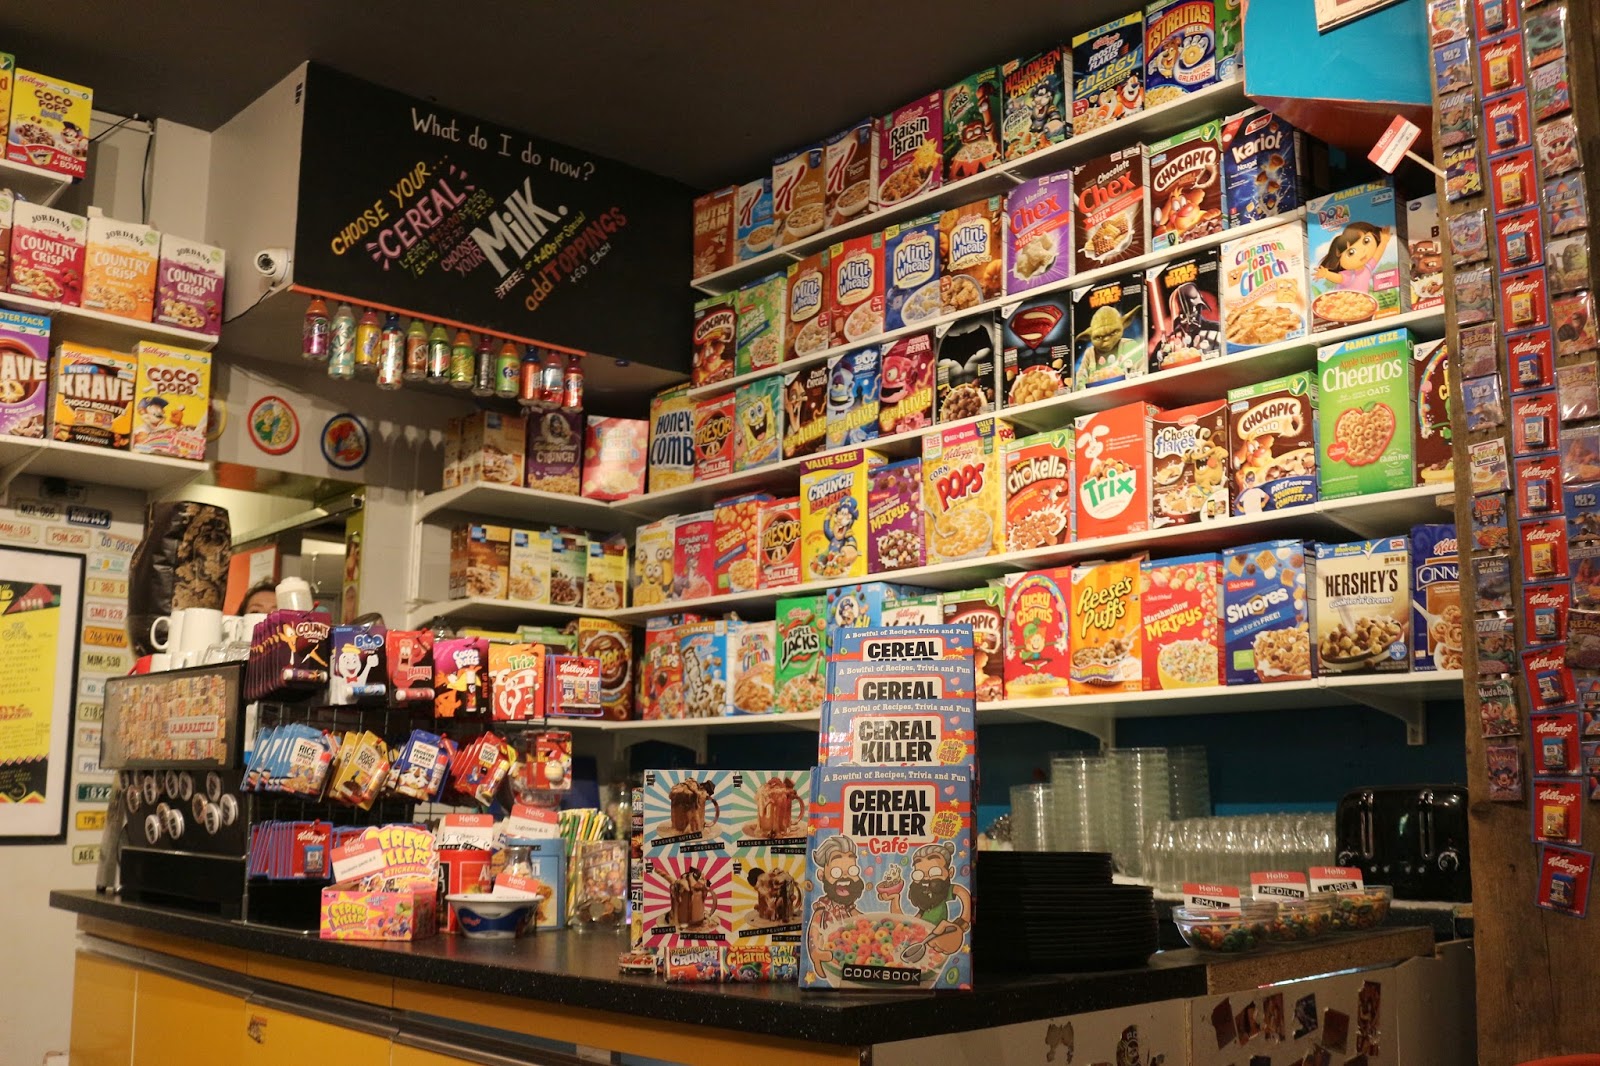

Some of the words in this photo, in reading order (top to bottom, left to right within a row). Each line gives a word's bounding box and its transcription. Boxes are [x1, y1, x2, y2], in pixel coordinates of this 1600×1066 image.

[1088, 17, 1126, 38] NEW!
[1147, 5, 1210, 51] ESTRELITAS
[1185, 25, 1206, 35] MEL
[1088, 38, 1124, 65] FROSTED
[1089, 50, 1119, 72] FLAKES
[1004, 50, 1061, 91] HALLOWEEN
[1009, 62, 1054, 98] CRUNCH
[34, 89, 73, 107] COCO
[38, 99, 68, 114] POPS
[888, 116, 929, 148] Raisin
[411, 107, 460, 142] What
[468, 126, 488, 150] do
[498, 134, 512, 157] I
[521, 142, 541, 165] do
[550, 157, 595, 181] now?
[892, 132, 925, 160] Bran
[59, 161, 84, 173] BOWL
[1097, 160, 1130, 183] Chocolate
[1155, 148, 1215, 191] CHOCAPIC
[1078, 170, 1135, 214] Chex
[31, 214, 71, 233] JORDANS
[377, 178, 467, 259] CEREAL
[1010, 197, 1061, 234] Chex
[330, 200, 390, 256] CHOOSE
[20, 234, 78, 262] COUNTRY
[105, 230, 145, 247] JORDANS
[441, 235, 476, 272] CHOOSE
[590, 242, 612, 265] EACH
[951, 235, 986, 262] Wheats
[1235, 241, 1284, 264] Cinnamon
[94, 251, 151, 276] COUNTRY
[455, 248, 486, 278] YOUR
[525, 272, 554, 311] add
[542, 206, 627, 282] TOPPINGS
[896, 254, 930, 279] Wheats
[1246, 254, 1276, 273] Toast
[166, 267, 218, 292] COUNTRY
[1167, 264, 1199, 278] STAR
[1240, 262, 1290, 297] Crunch
[500, 270, 522, 295] FREE
[839, 272, 871, 292] Wheats
[1092, 286, 1121, 300] STAR
[22, 316, 44, 327] PACK
[696, 313, 732, 338] CHOCAPIC
[906, 341, 930, 354] BERRY
[1344, 338, 1375, 351] FAMILY
[1377, 332, 1399, 345] SIZE
[68, 366, 92, 374] NEW
[147, 366, 199, 385] COCO
[1322, 358, 1403, 393] Cheerios
[59, 373, 135, 401] KRAVE
[1366, 384, 1391, 396] OATS
[64, 399, 91, 408] CHOCO
[1518, 404, 1552, 415] Kellogg's
[1242, 402, 1296, 433] CHOCAPIC
[926, 437, 941, 447] FREE
[1163, 426, 1197, 442] Choco
[651, 435, 694, 465] COMB
[1155, 436, 1196, 457] flakes
[805, 456, 834, 469] VALUE
[835, 452, 858, 465] SIZE!
[929, 465, 949, 481] CORN
[1522, 466, 1556, 479] Kellogg's
[807, 472, 855, 500] CRUNCH
[936, 462, 985, 513] POPS
[1083, 468, 1136, 508] Trix
[1526, 530, 1560, 542] Kellogg's
[1325, 569, 1398, 598] HERSHEY'S
[1078, 576, 1132, 615] Reese's
[1529, 594, 1564, 606] Kellogg's
[1016, 607, 1053, 626] Charms
[1082, 597, 1126, 639] Puffs
[1143, 601, 1188, 624] Marshmallow
[1260, 611, 1281, 625] FREE!
[296, 622, 330, 637] COUNT
[789, 626, 811, 638] APPLE
[853, 630, 878, 638] Bowlful
[354, 634, 384, 648] BOO
[867, 641, 939, 659] CEREAL
[781, 635, 819, 670] JACKS
[508, 656, 535, 671] Trix
[839, 668, 844, 676] A
[847, 665, 874, 674] Bowlful
[956, 666, 970, 674] Fun
[862, 681, 938, 700] CEREAL
[842, 705, 870, 714] Bowlful
[956, 705, 970, 713] Fun
[858, 720, 937, 741] CEREAL
[299, 745, 316, 755] RICE
[860, 741, 932, 763] KILLER
[824, 774, 830, 782] A
[832, 771, 862, 781] Bowlful
[864, 771, 872, 779] of
[908, 771, 932, 779] Trivia
[934, 772, 949, 780] and
[951, 773, 967, 782] Fun
[849, 789, 931, 813] CEREAL
[525, 808, 545, 818] Hello
[852, 813, 926, 837] KILLER
[868, 836, 909, 855] Café
[1266, 872, 1289, 880] Hello
[1325, 867, 1346, 876] Hello
[1199, 885, 1222, 893] Hello
[1261, 886, 1301, 898] MEDIUM
[1321, 882, 1354, 893] LARGE
[671, 952, 718, 967] CRUNCH
[726, 951, 771, 966] Charms
[843, 967, 920, 982] COOKBOOK
